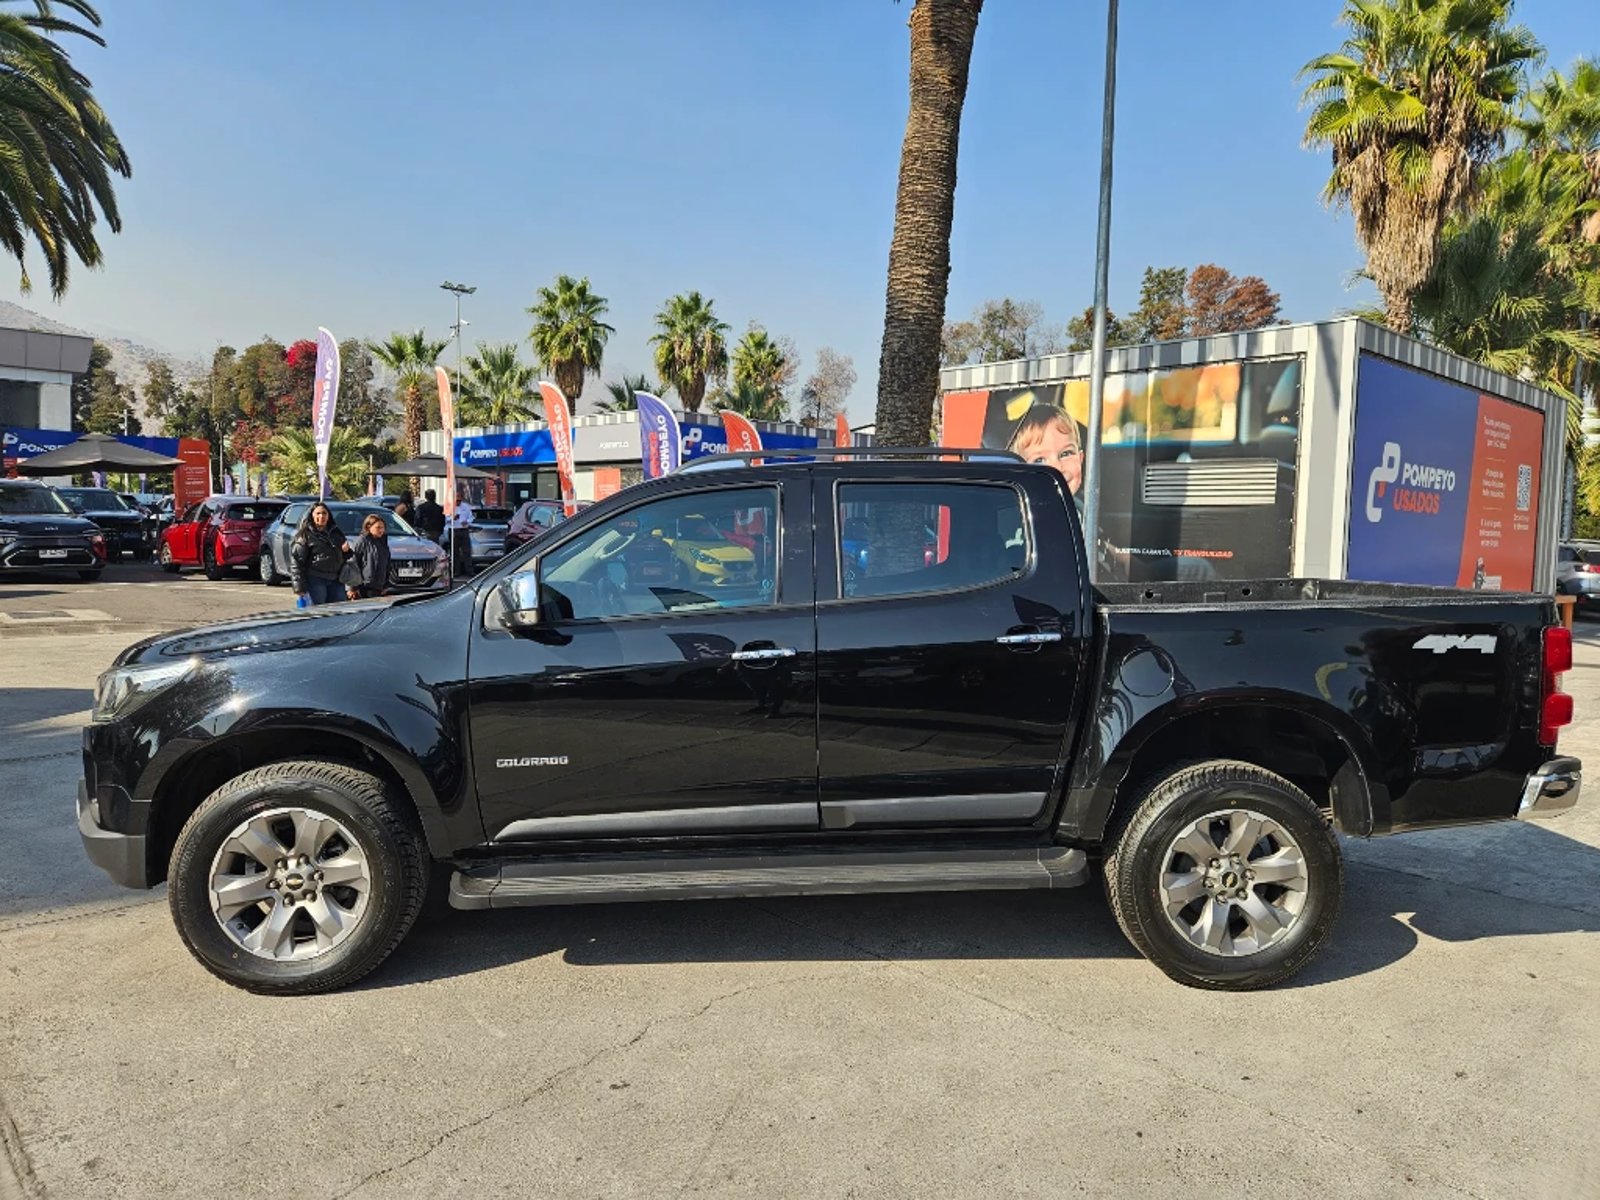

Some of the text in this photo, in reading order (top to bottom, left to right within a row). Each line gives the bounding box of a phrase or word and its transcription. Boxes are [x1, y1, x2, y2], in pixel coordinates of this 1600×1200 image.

[1401, 462, 1455, 491] POMPEYO
[1393, 488, 1440, 514] USADOS
[496, 755, 569, 768] COLORADO
